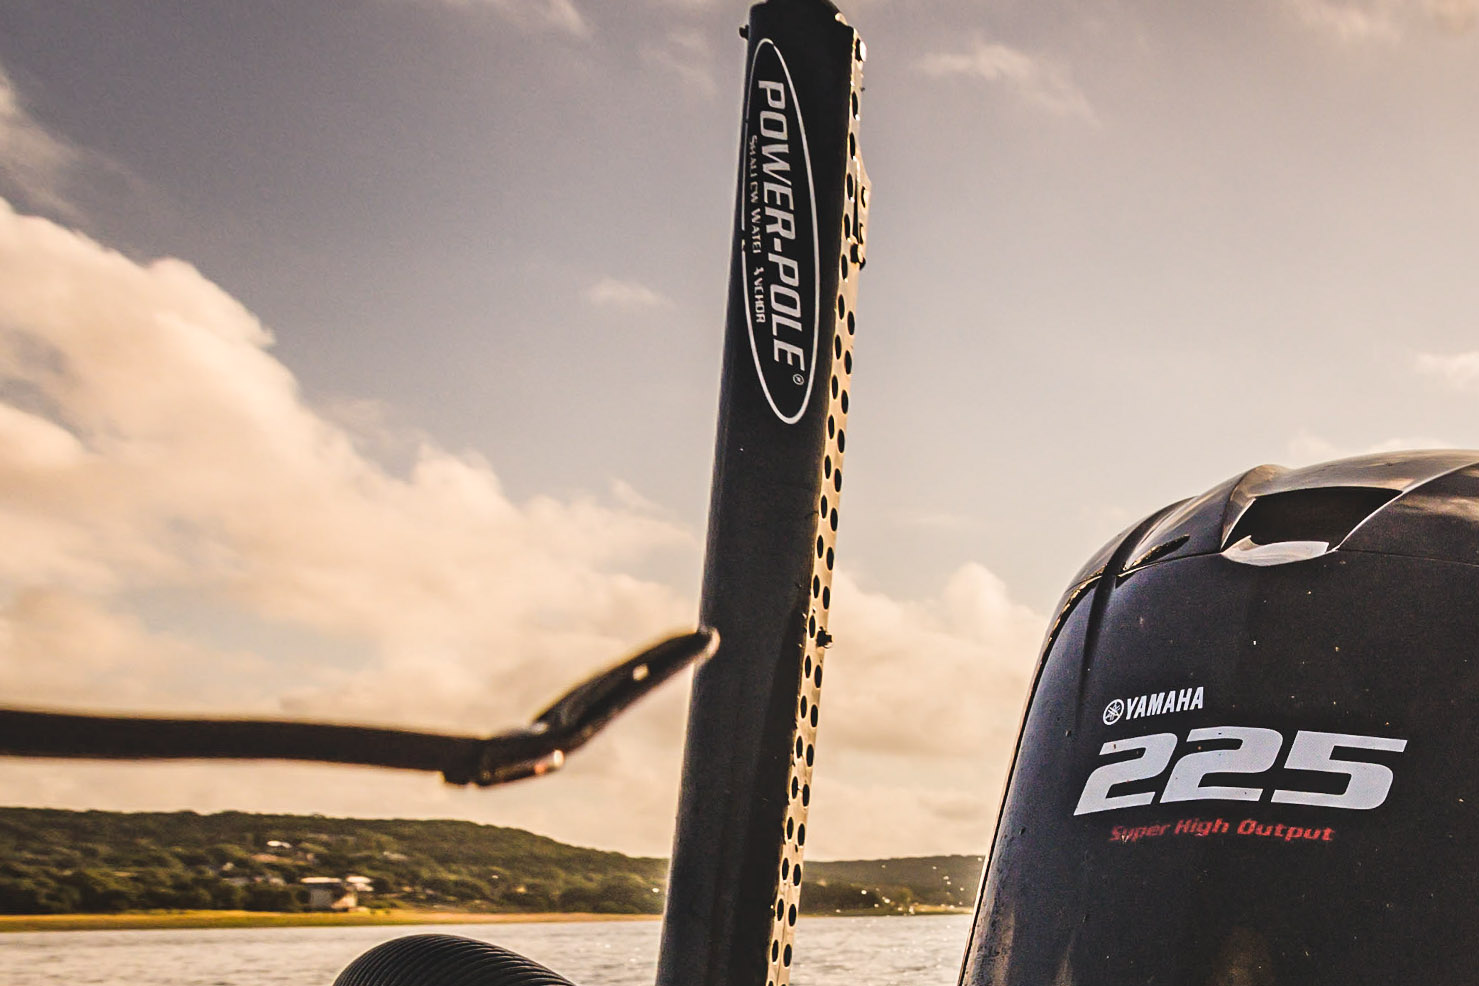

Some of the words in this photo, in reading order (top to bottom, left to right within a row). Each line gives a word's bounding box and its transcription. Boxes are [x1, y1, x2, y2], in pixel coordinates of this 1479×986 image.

[757, 79, 806, 376] POWER-POLE
[1125, 686, 1205, 721] YAMAHA
[1073, 725, 1408, 816] 225
[1109, 823, 1171, 843] Super
[1173, 817, 1230, 838] High
[1236, 818, 1337, 843] Output
